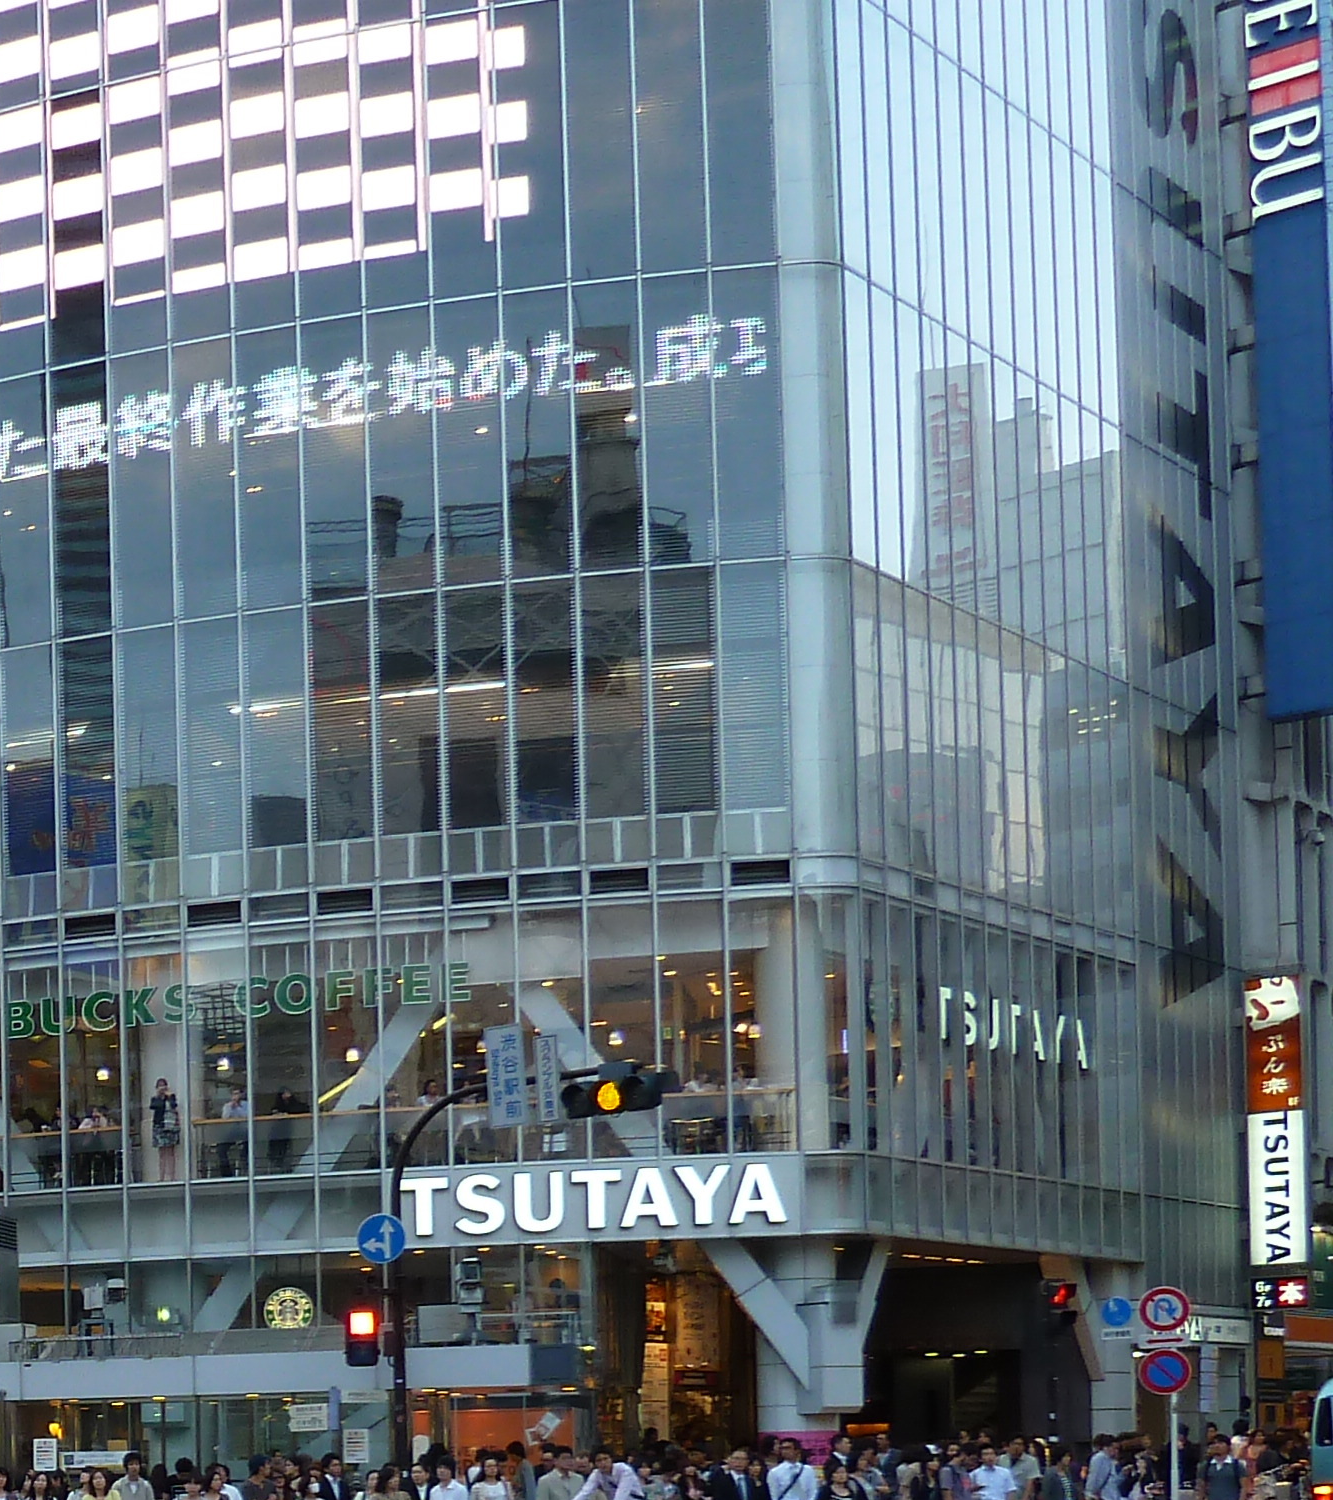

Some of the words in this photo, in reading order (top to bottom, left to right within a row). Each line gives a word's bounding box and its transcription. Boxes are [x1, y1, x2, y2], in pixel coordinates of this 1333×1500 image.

[1245, 0, 1325, 223] EIBU
[233, 960, 472, 1018] COFFEE
[938, 985, 1089, 1070] TSUTAYA
[399, 1163, 788, 1237] TSUTAYA
[1262, 1111, 1292, 1264] TSUTAYA
[1278, 1281, 1304, 1304] 本
